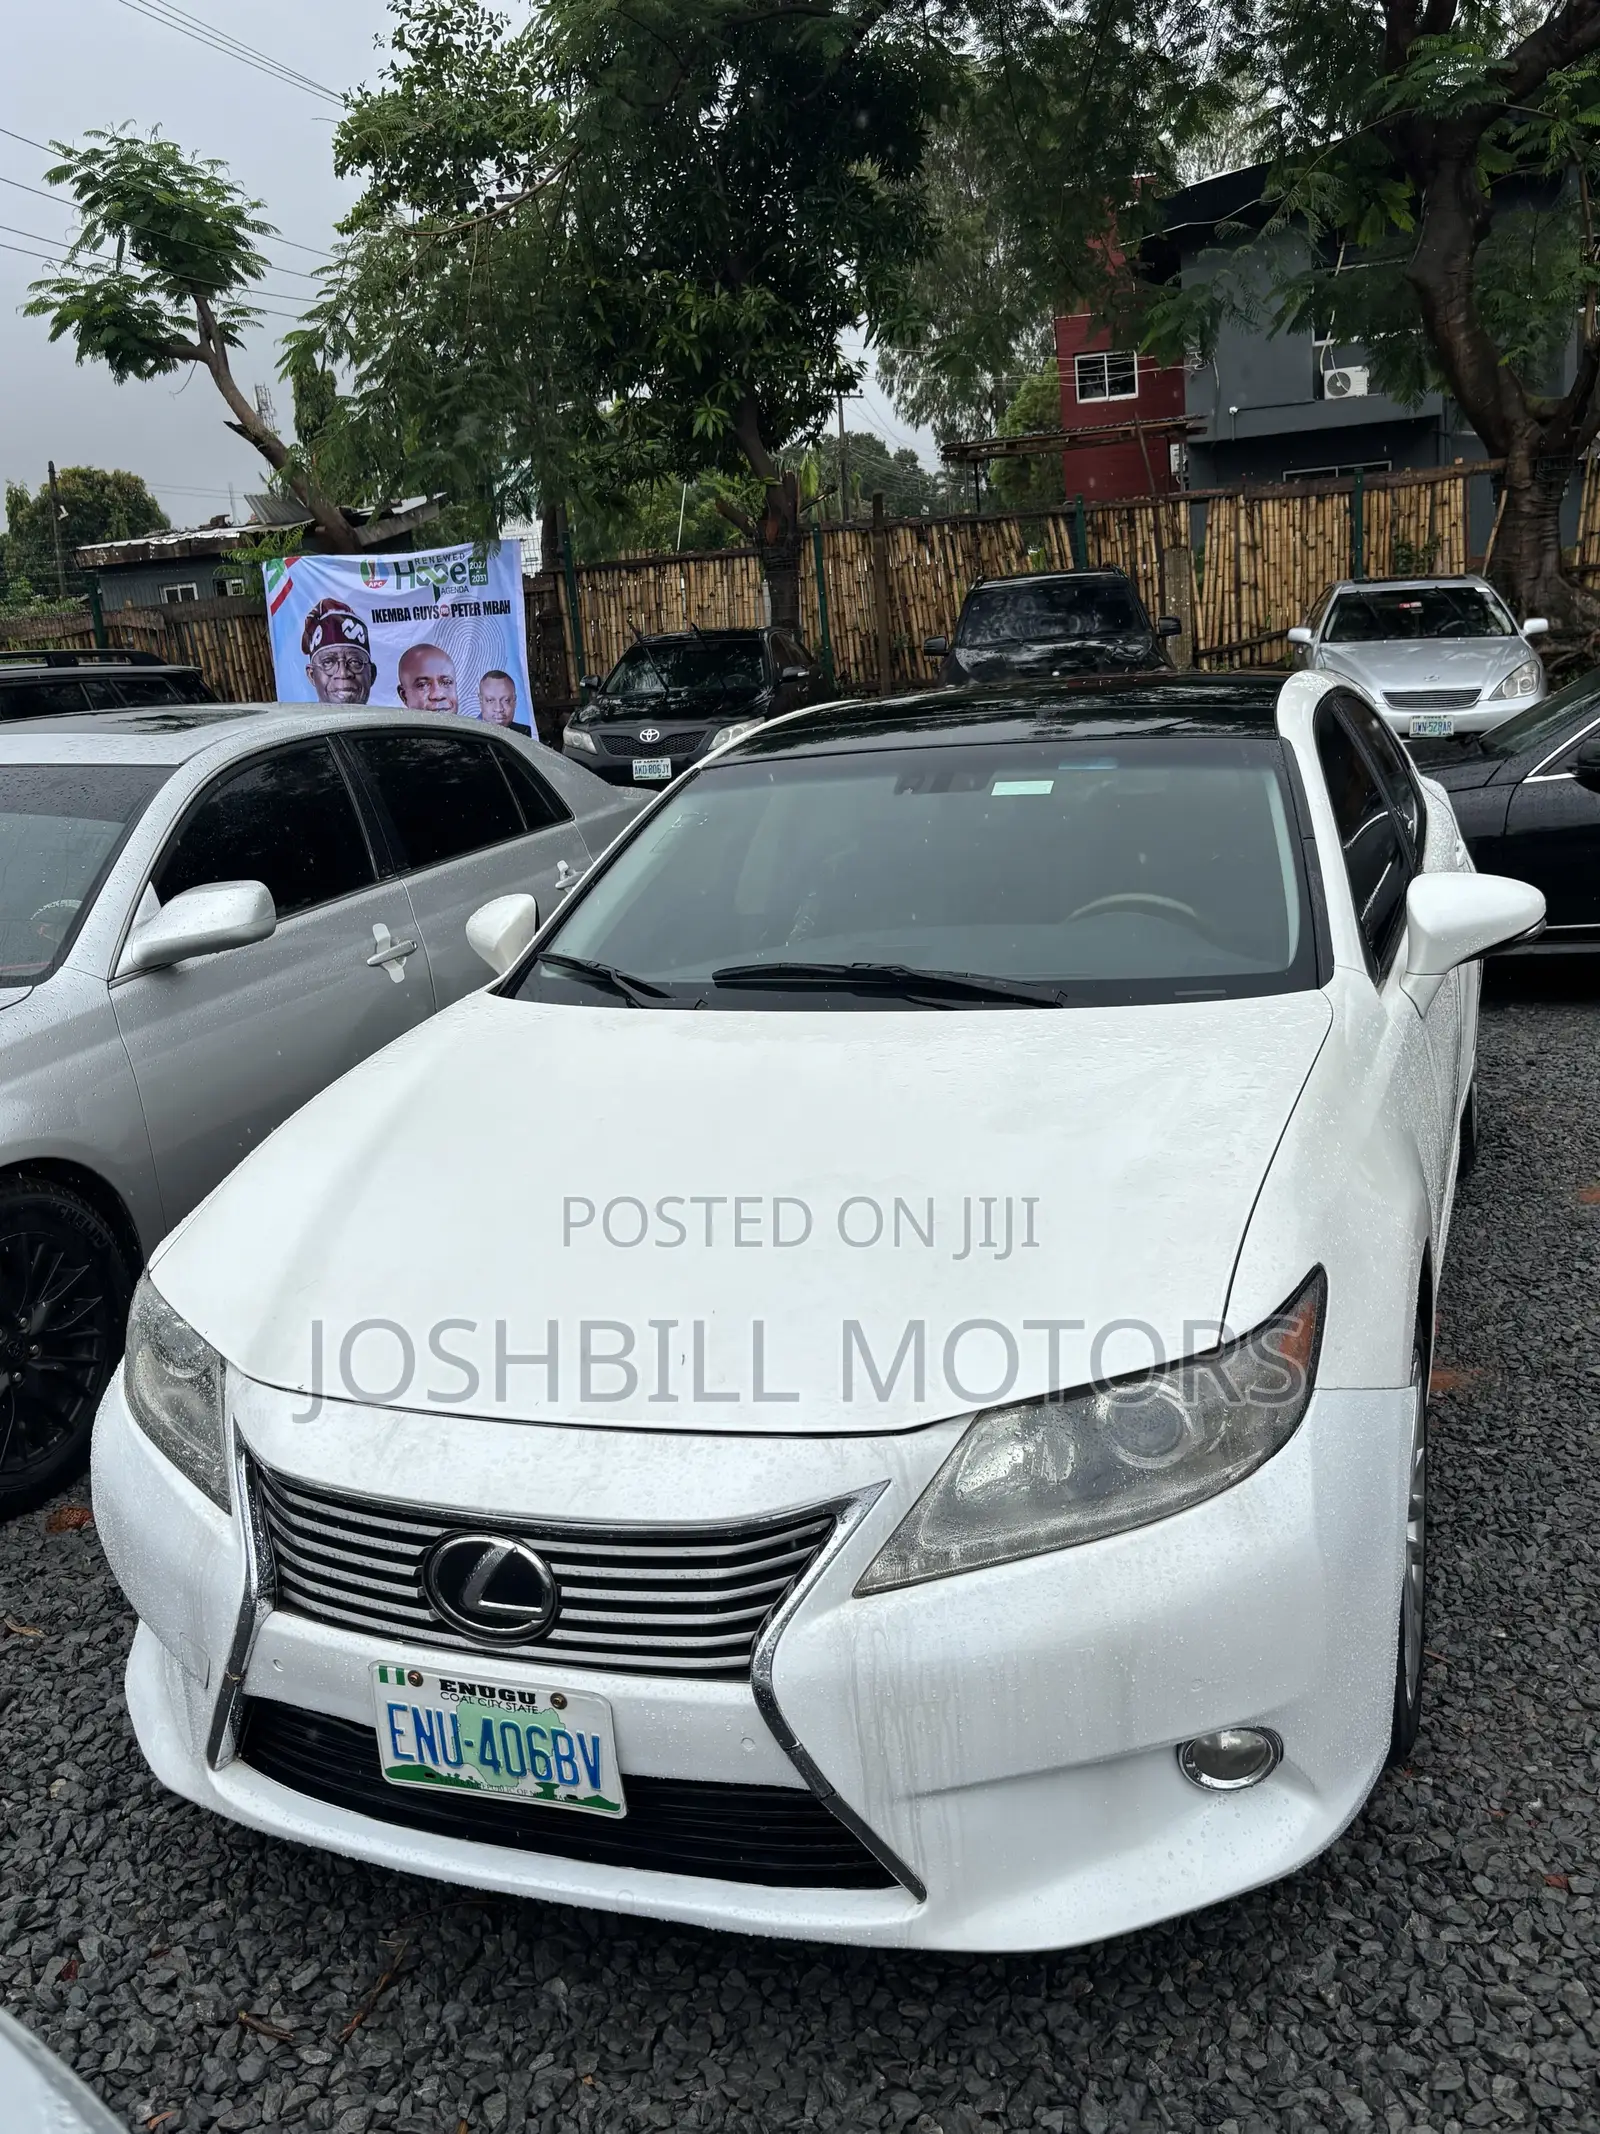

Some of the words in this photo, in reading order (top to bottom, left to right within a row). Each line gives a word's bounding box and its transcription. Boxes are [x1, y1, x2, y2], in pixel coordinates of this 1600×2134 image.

[414, 553, 466, 565] RENEWED
[368, 580, 383, 588] APC
[393, 560, 467, 604] Hope
[440, 585, 470, 595] AGENDA
[471, 574, 487, 583] 2031
[371, 607, 411, 623] IKEMBA
[412, 604, 440, 621] GUYS
[450, 602, 481, 618] PETER
[483, 600, 511, 616] MBAH
[438, 1678, 536, 1705] ENUGU
[440, 1691, 475, 1706] COAL
[477, 1697, 502, 1709] CITY
[505, 1703, 539, 1715] STATE
[386, 1701, 601, 1791] ENU-406BV
